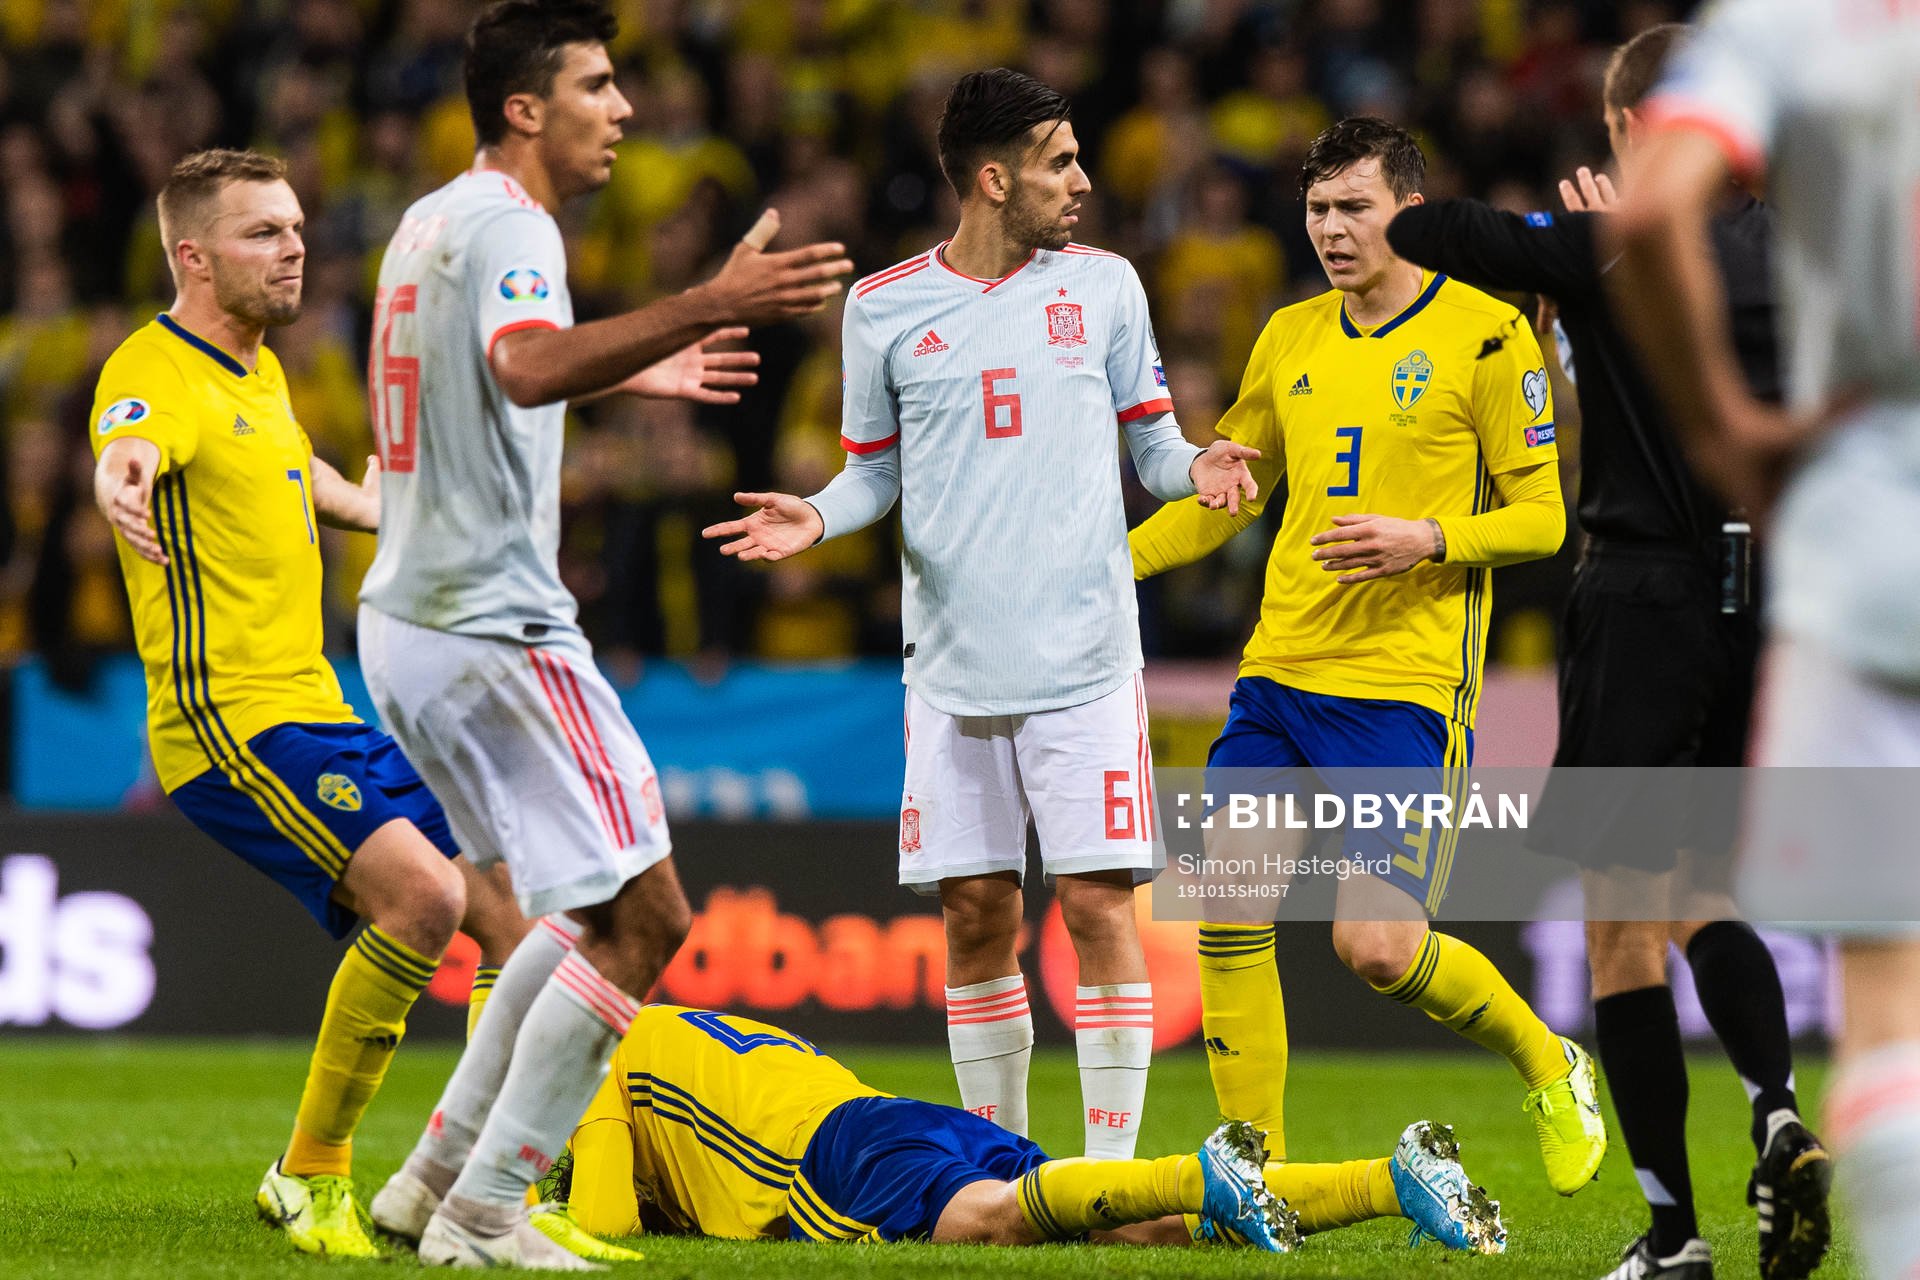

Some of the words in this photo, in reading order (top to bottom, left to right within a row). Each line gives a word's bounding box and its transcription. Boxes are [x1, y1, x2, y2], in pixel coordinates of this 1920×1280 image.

[913, 343, 950, 357] adidas
[981, 367, 1022, 440] 6
[1327, 426, 1363, 497] 3
[286, 469, 315, 545] 7
[1103, 770, 1136, 840] 6
